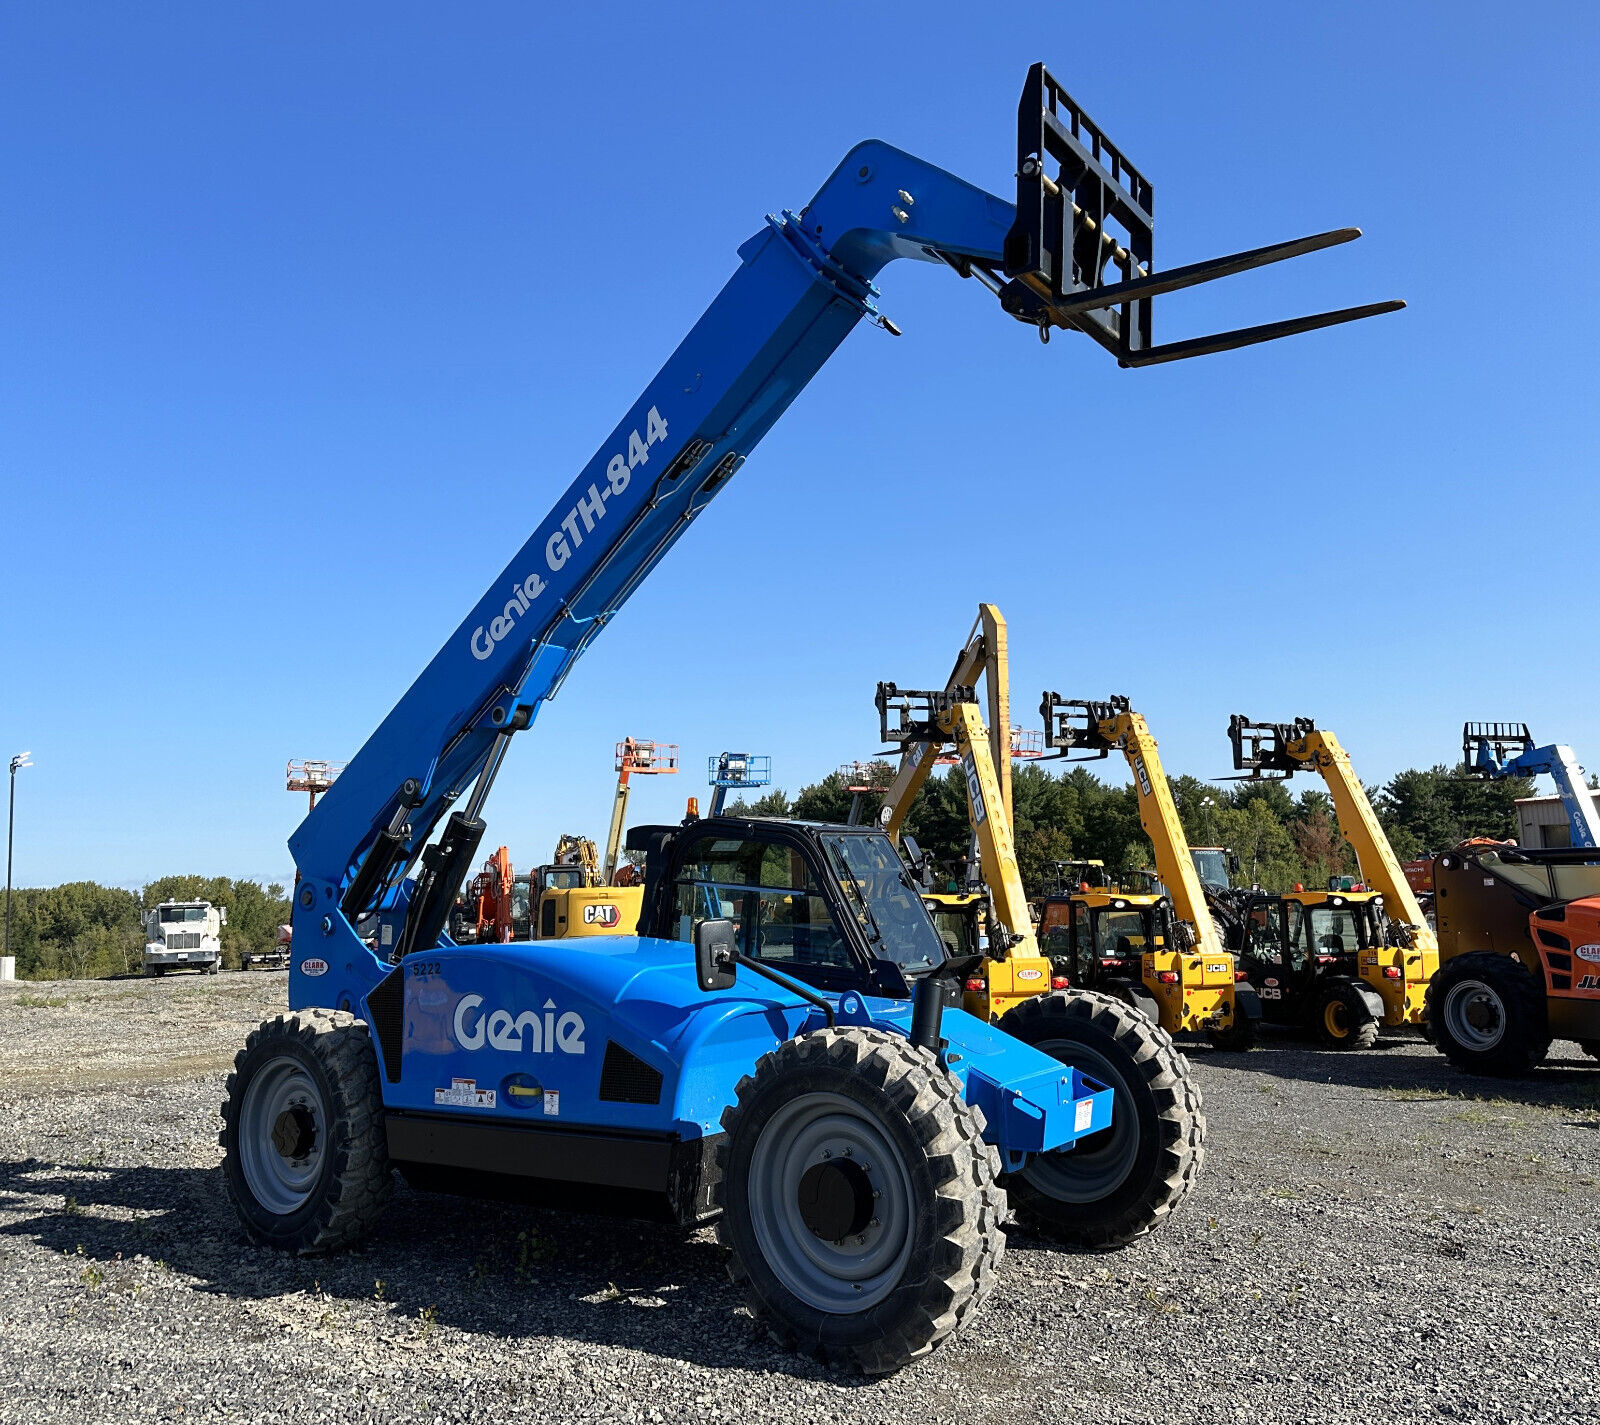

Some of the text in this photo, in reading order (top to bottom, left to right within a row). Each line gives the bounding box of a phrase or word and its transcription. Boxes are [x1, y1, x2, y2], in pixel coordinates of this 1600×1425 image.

[471, 405, 669, 661] Genie GTH-844
[1134, 758, 1151, 796] JCB
[1573, 811, 1587, 839] Genie
[584, 905, 613, 924] CAT
[1213, 900, 1239, 925] DOOSAN
[304, 961, 325, 969] CLARK
[413, 962, 441, 976] 5222
[1205, 964, 1228, 972] JCB
[1257, 988, 1281, 999] JCB
[454, 993, 586, 1054] Genie
